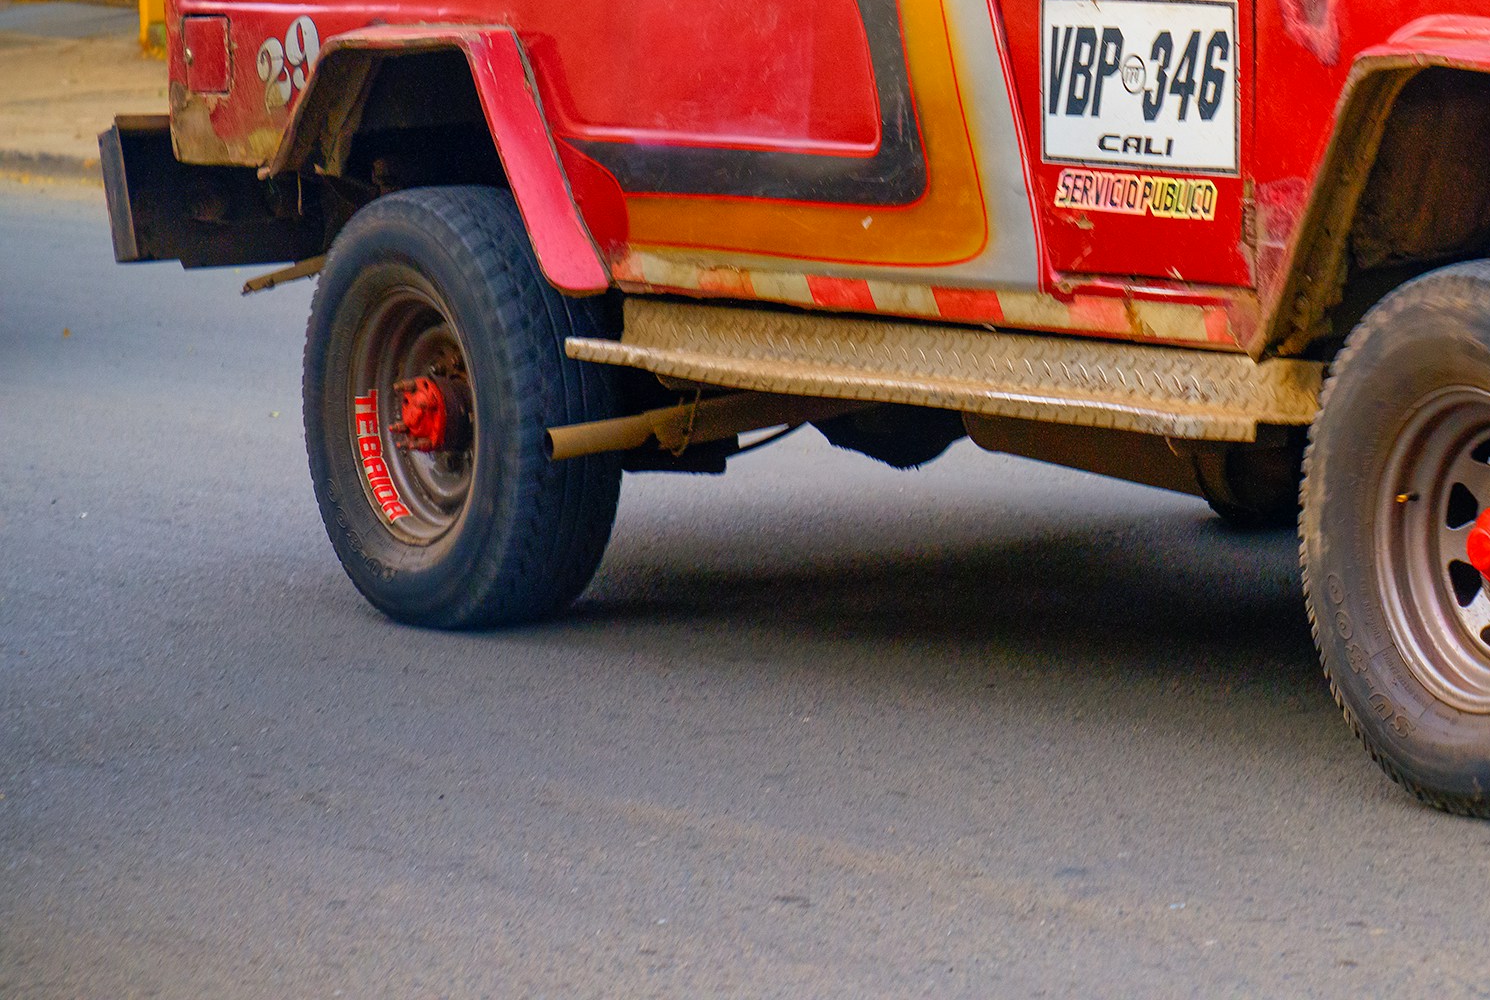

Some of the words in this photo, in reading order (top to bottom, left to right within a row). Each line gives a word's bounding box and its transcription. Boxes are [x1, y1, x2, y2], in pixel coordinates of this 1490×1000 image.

[256, 15, 320, 113] 29
[1049, 26, 1124, 117] VBP
[1142, 30, 1230, 122] 346
[1098, 134, 1174, 157] CALI
[1057, 172, 1140, 209] SERVICIO
[1141, 175, 1214, 214] PUBLICO
